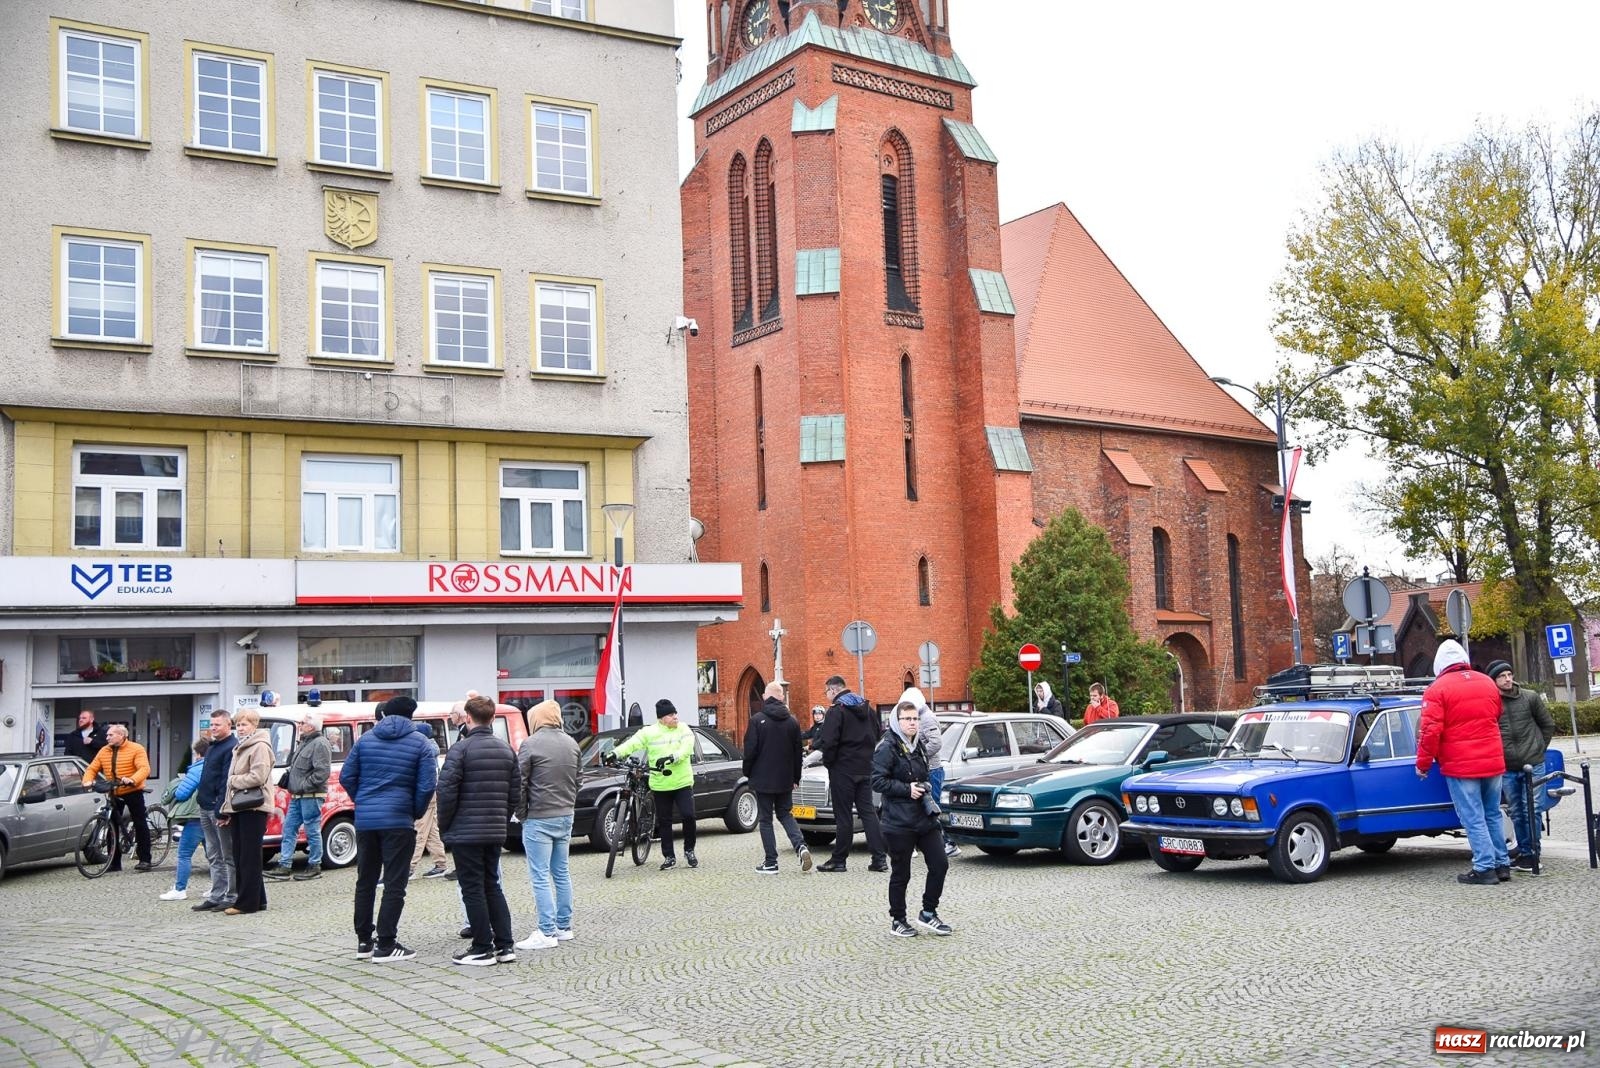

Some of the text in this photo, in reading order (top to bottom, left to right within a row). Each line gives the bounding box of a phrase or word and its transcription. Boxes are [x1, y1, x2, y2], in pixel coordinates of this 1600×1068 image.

[118, 564, 173, 582] TEB
[428, 564, 632, 593] ROSSMANN
[117, 585, 173, 595] EDUKACJA
[1337, 635, 1345, 646] P
[1552, 628, 1568, 649] P
[1264, 711, 1307, 722] Marlboro
[1162, 837, 1204, 851] SRC 00883
